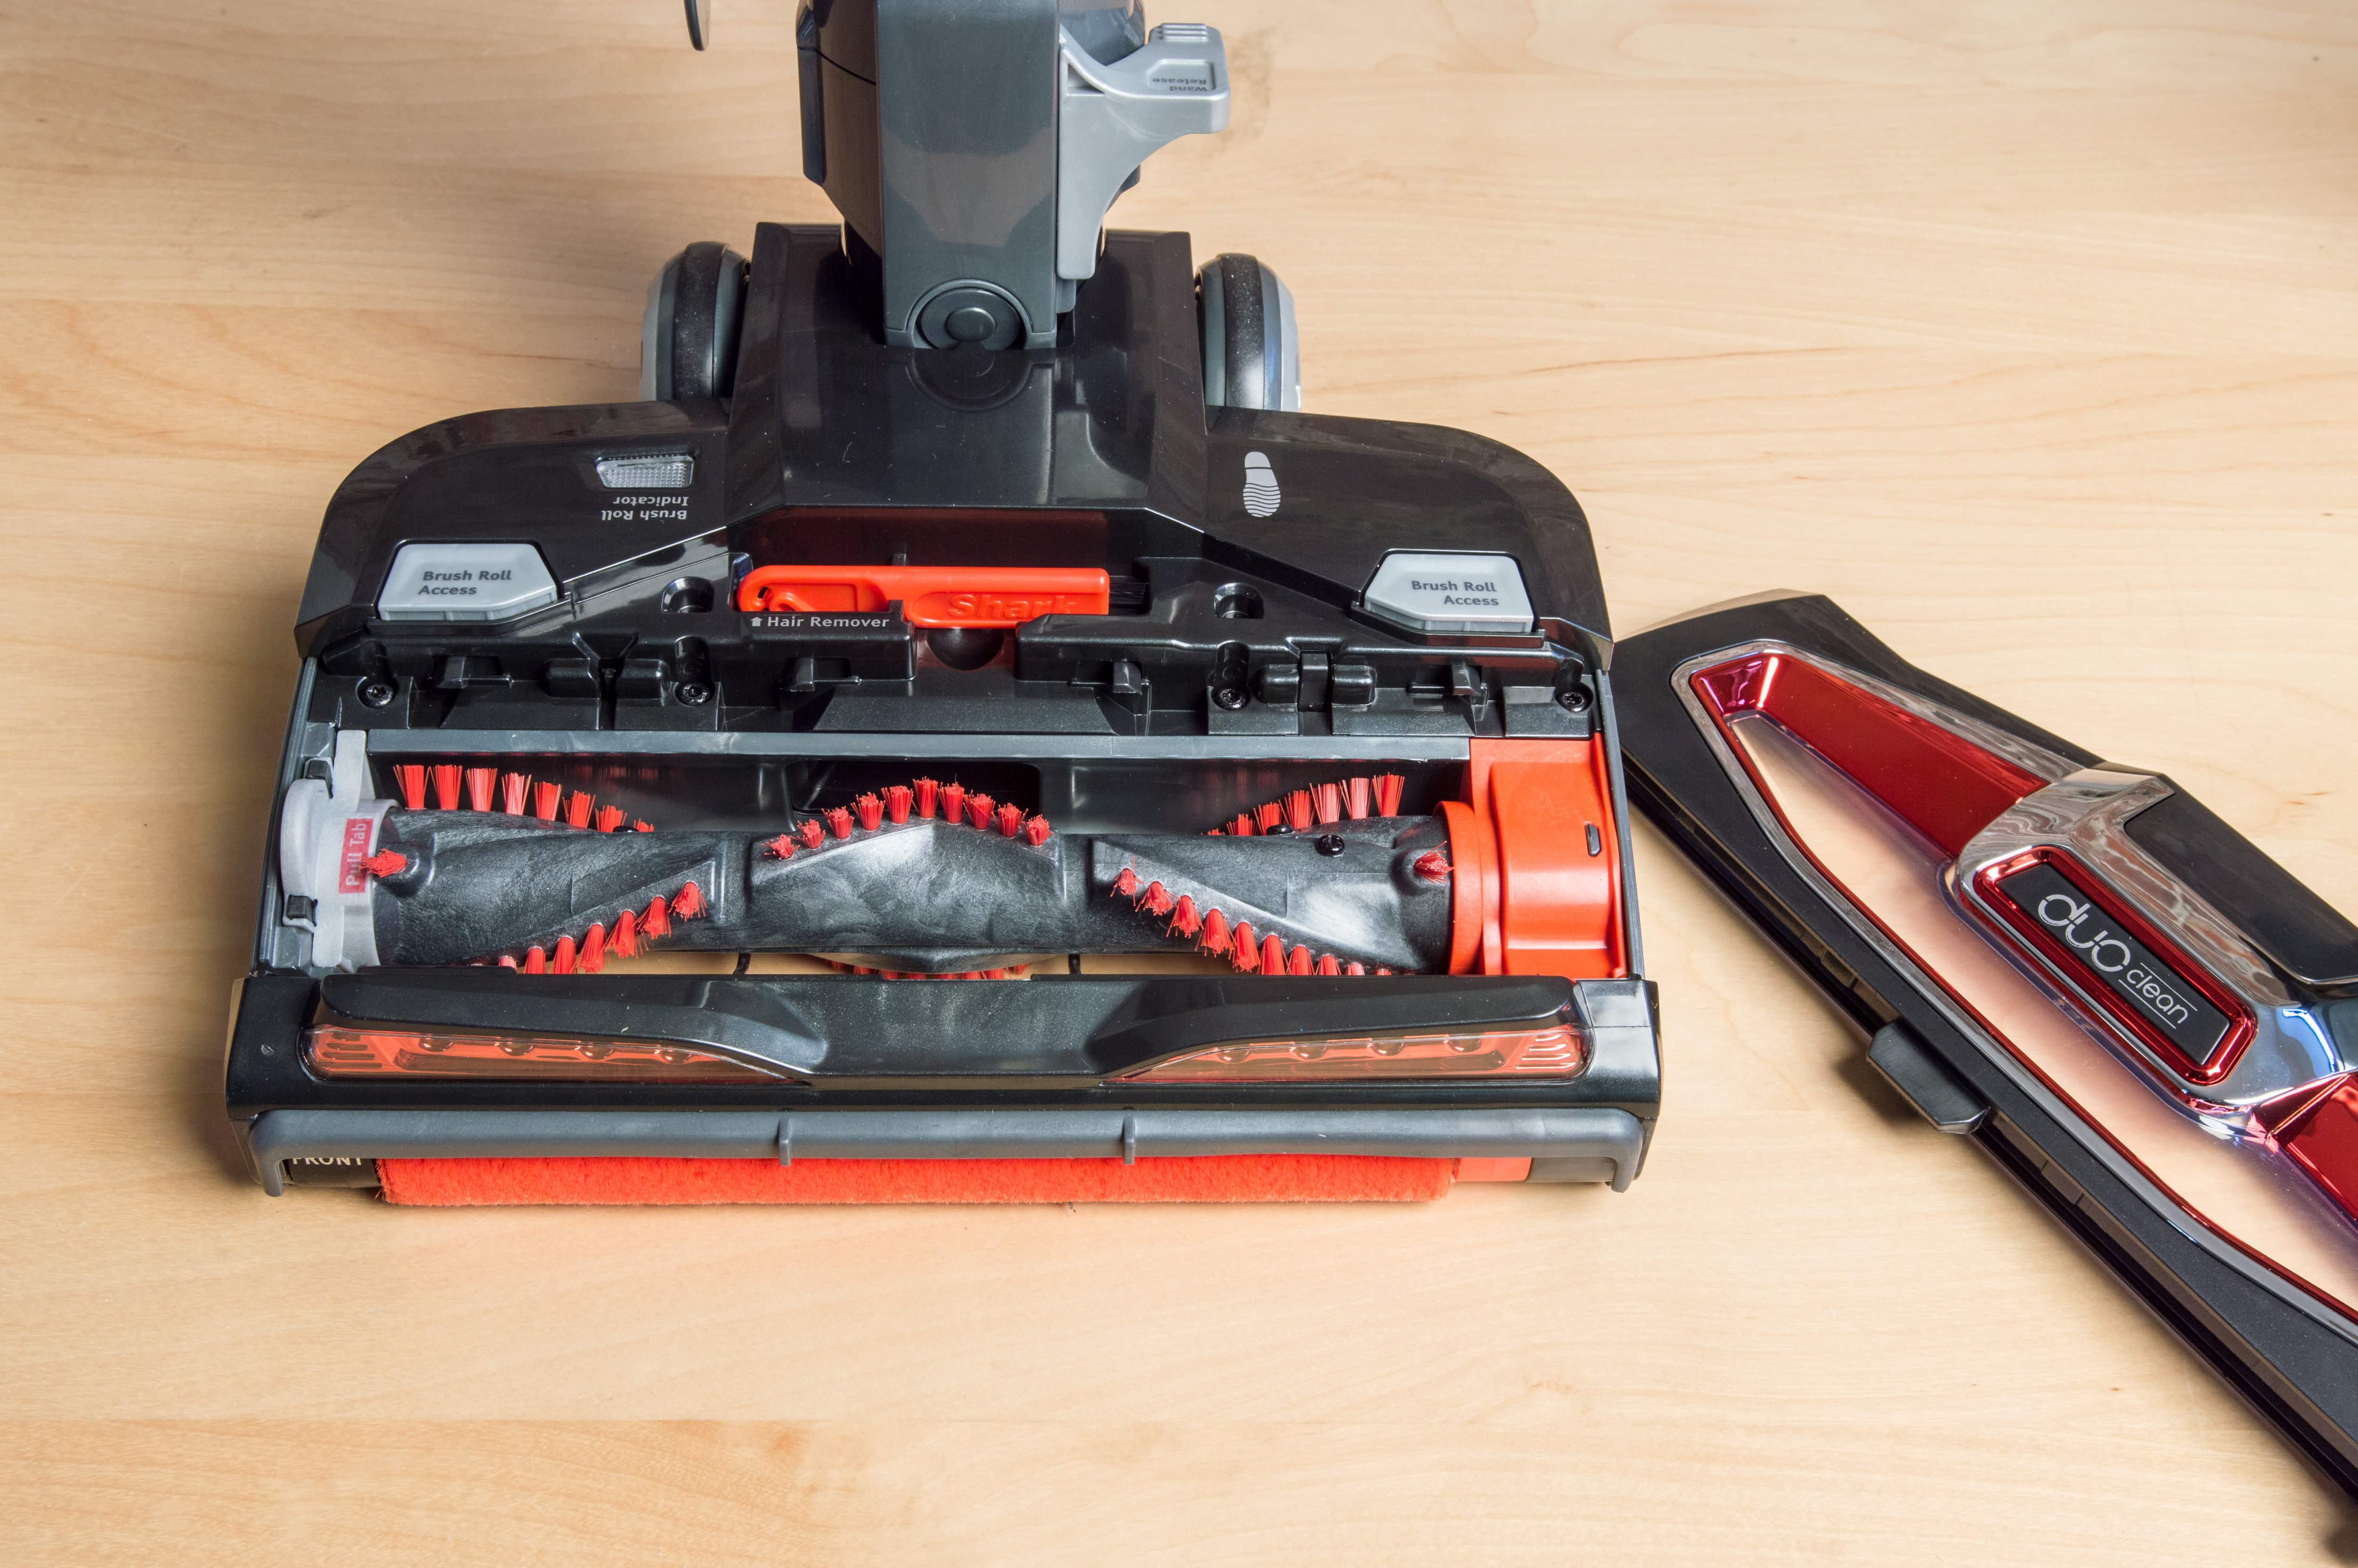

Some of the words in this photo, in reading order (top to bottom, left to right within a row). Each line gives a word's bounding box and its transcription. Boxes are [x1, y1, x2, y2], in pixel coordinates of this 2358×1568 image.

[613, 496, 689, 507] Indicator
[601, 510, 633, 520] Roll
[640, 510, 687, 520] Brush
[423, 570, 472, 581] Brush
[478, 569, 512, 581] Roll
[418, 585, 477, 595] Access
[1411, 580, 1458, 591] Brush
[1464, 581, 1497, 592] Roll
[947, 593, 1076, 619] Shark
[1443, 595, 1499, 606] Access
[767, 616, 804, 627] Hair
[810, 616, 890, 627] Remover
[349, 823, 367, 847] Tab
[2038, 894, 2131, 972] duo
[2126, 969, 2189, 1024] clean
